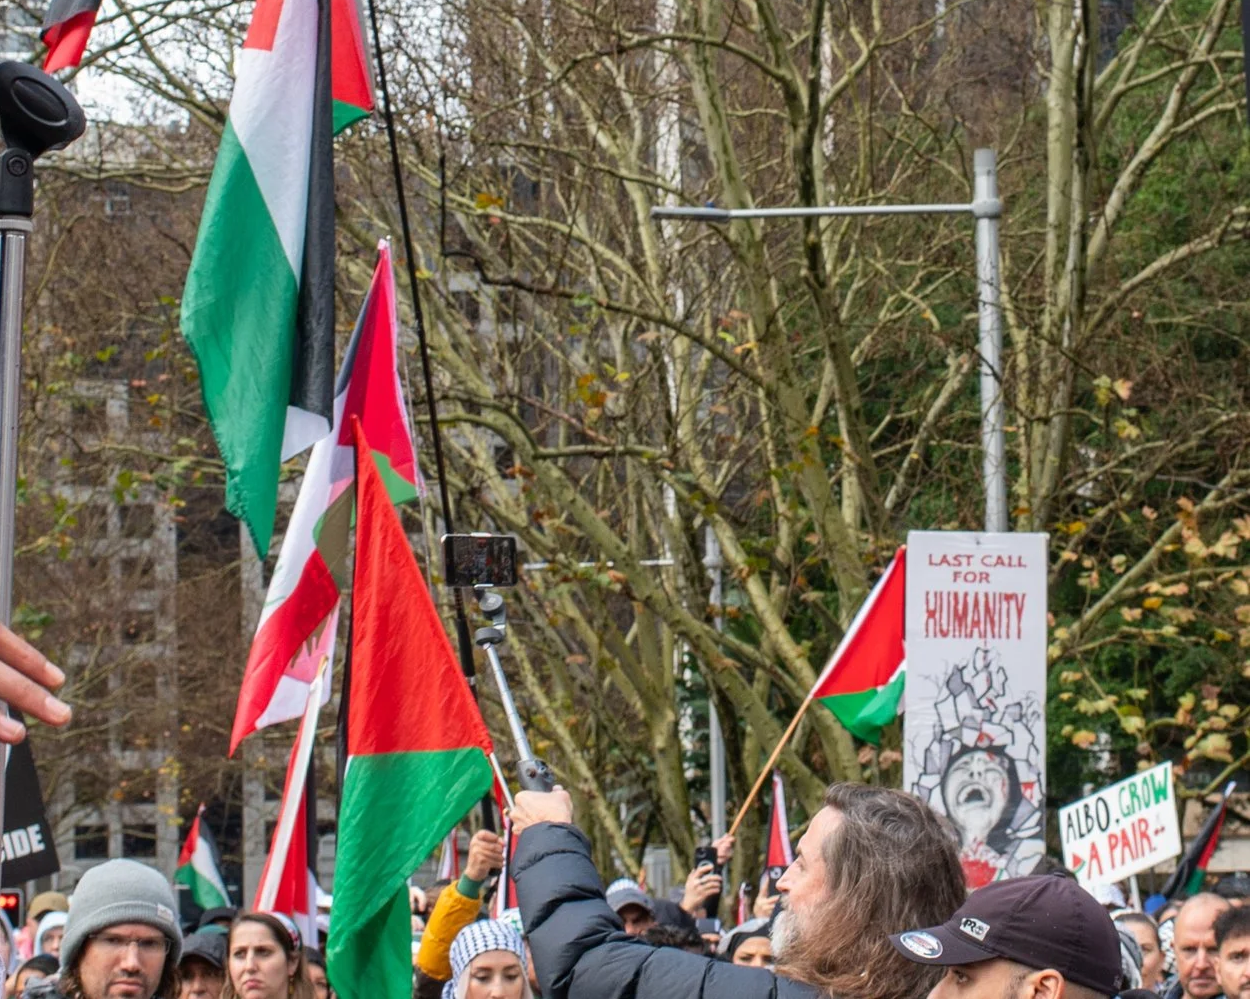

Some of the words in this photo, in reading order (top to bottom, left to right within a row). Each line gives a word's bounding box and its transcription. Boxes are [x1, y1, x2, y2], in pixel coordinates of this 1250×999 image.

[928, 553, 974, 567] LAST
[981, 555, 1027, 568] CALL
[953, 571, 991, 584] FOR
[925, 591, 1026, 640] HUMANITY
[1118, 767, 1168, 818] GROW
[1, 823, 46, 863] IDE
[1088, 841, 1103, 880] A
